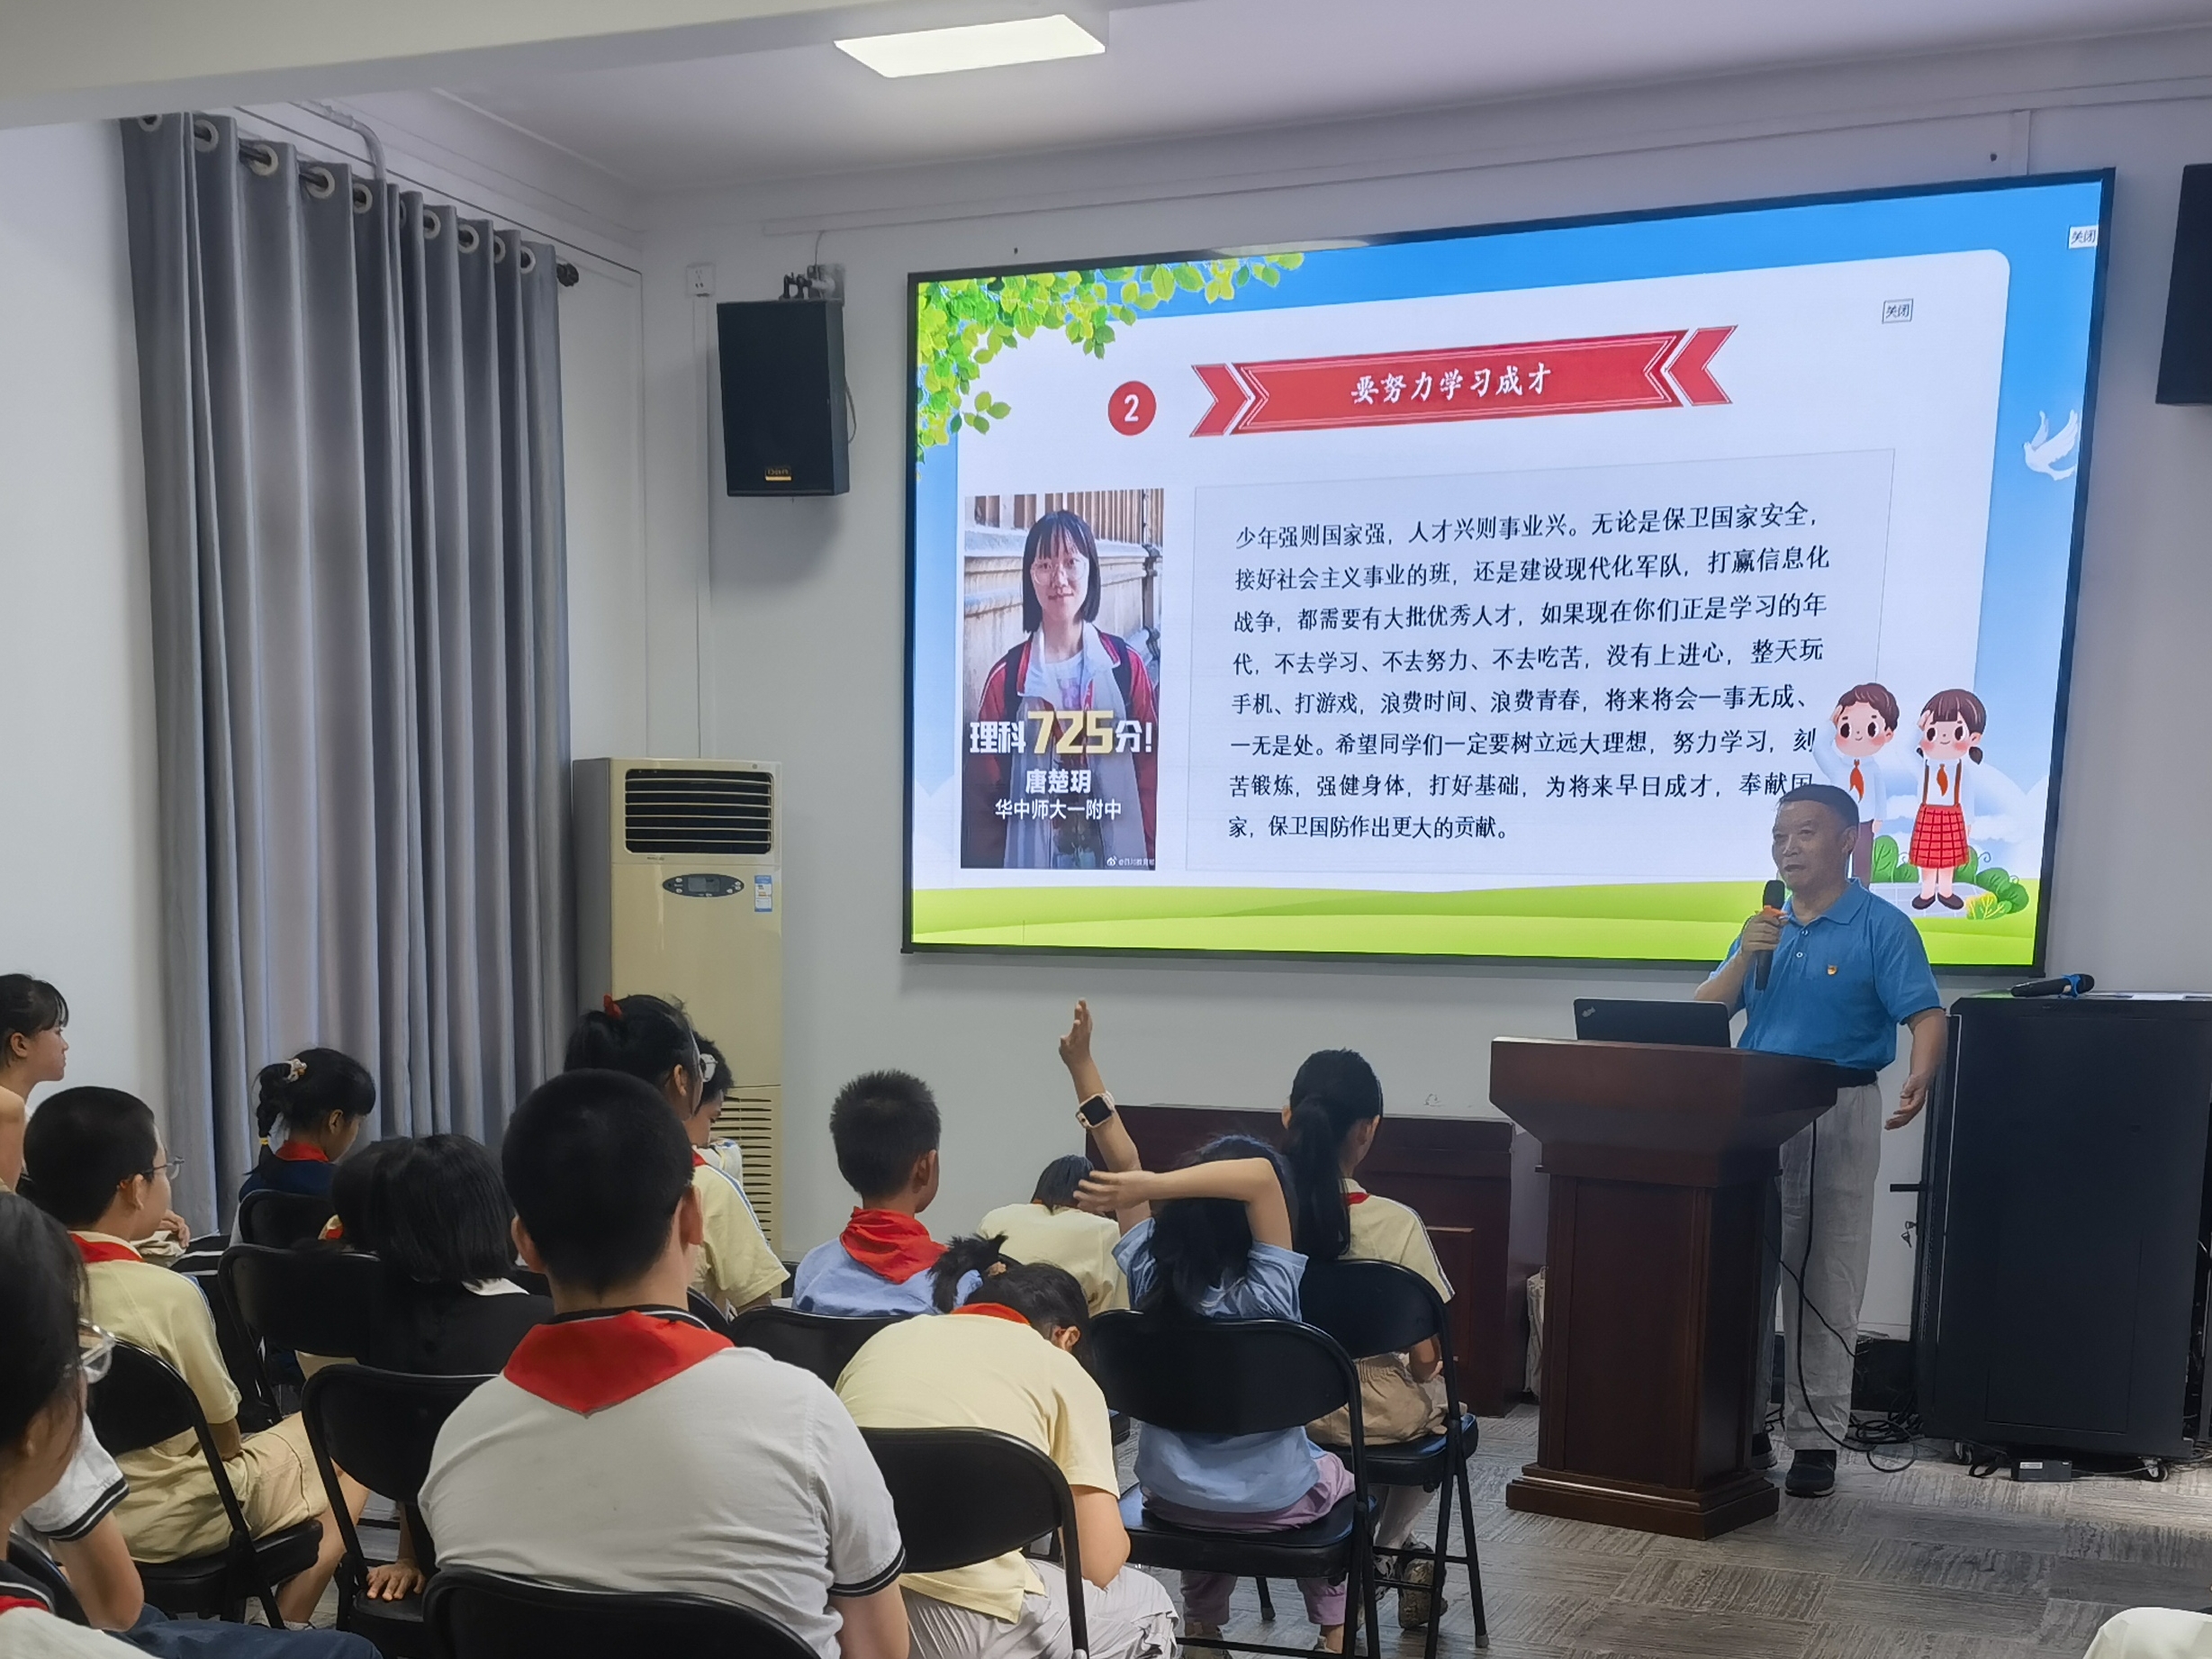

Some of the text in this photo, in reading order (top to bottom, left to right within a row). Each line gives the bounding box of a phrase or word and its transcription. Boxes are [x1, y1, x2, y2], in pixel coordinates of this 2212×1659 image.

[1351, 362, 1551, 404] 要努力学习成才
[1124, 393, 1140, 422] 2
[1025, 769, 1092, 795] 唐楚玥
[994, 798, 1123, 821] 华中师大一附中
[1228, 815, 1506, 840] 家，保卫国防作出更大的贡献。
